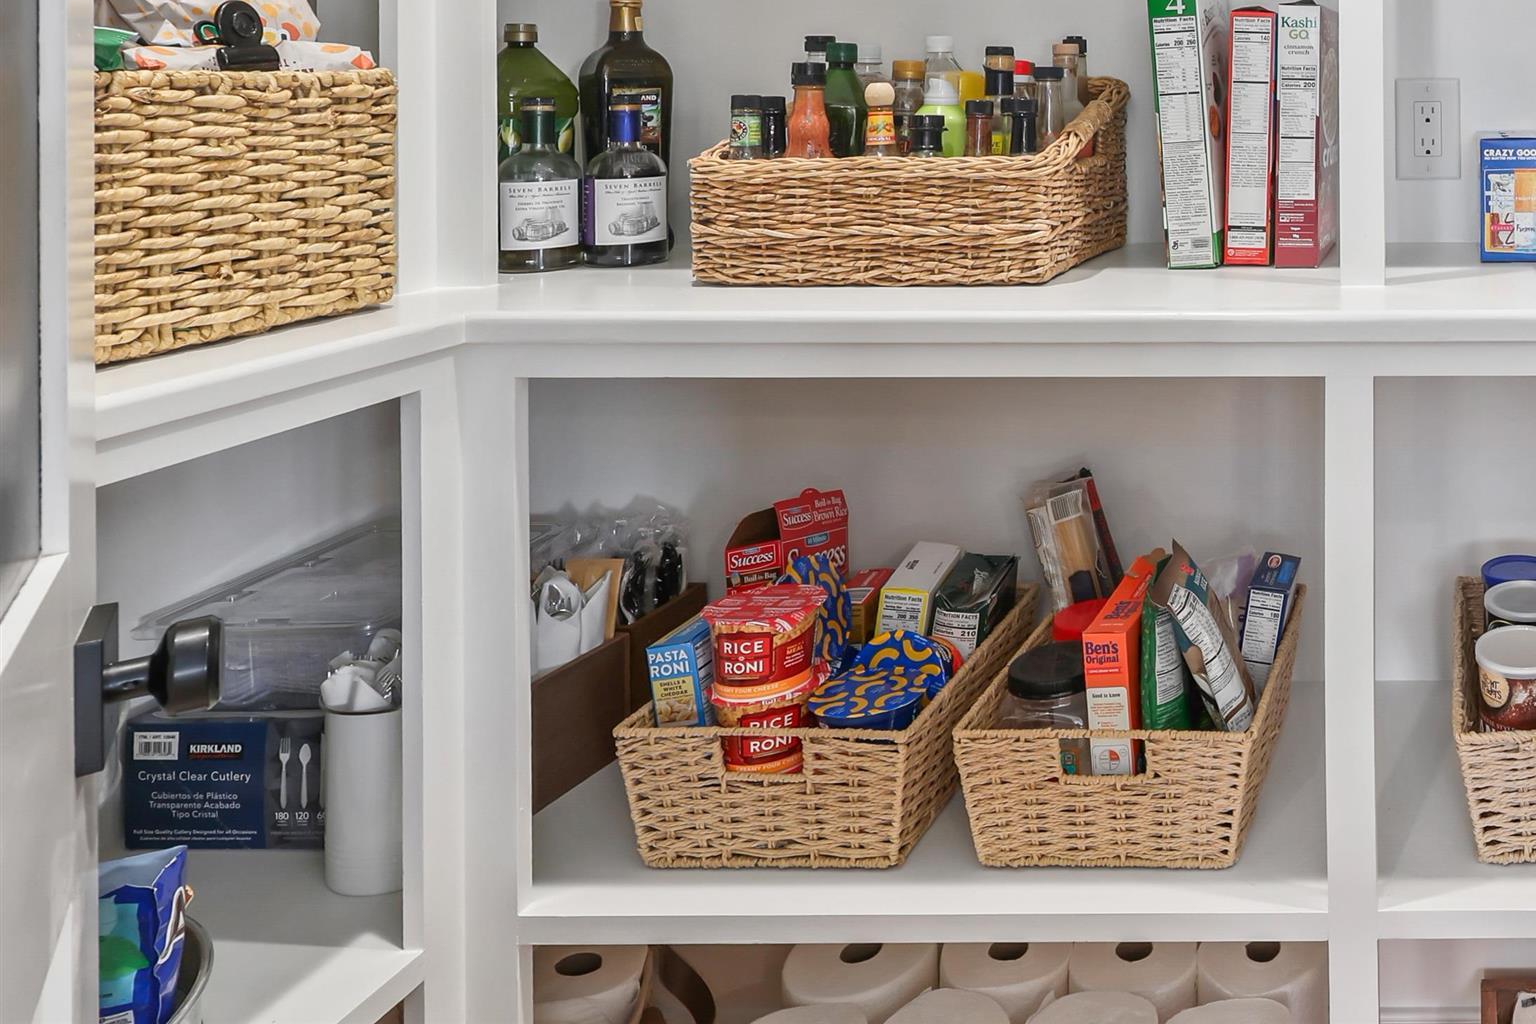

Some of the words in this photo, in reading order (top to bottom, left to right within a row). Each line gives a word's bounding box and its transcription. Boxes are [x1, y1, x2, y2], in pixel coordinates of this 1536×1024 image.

[1280, 16, 1317, 28] Kashi
[1483, 149, 1514, 157] CRAZY
[538, 185, 571, 193] BARRELS
[783, 511, 812, 527] Success
[813, 509, 835, 522] Brown
[835, 506, 848, 517] Rice
[730, 550, 774, 569] Success
[723, 640, 764, 655] RICE
[1085, 641, 1119, 655] Ben's
[648, 649, 689, 664] PASTA
[1085, 655, 1119, 666] Original
[650, 660, 690, 678] RONI
[724, 660, 763, 674] RONI
[660, 689, 689, 698] CHEDDAR
[750, 713, 794, 728] RICE
[189, 744, 242, 753] KIRKLAND
[750, 735, 793, 753] RONI
[137, 770, 176, 783] Crystal
[178, 770, 207, 782] Clear
[209, 770, 251, 783] Cutlery
[151, 791, 191, 801] Cubiertos
[193, 791, 204, 800] de
[205, 791, 238, 801] Plástico
[148, 801, 201, 811] Transparente
[203, 801, 241, 810] Acabado
[172, 810, 190, 820] Tipo
[191, 810, 219, 819] Cristal
[274, 811, 289, 820] 180
[295, 811, 309, 820] 120
